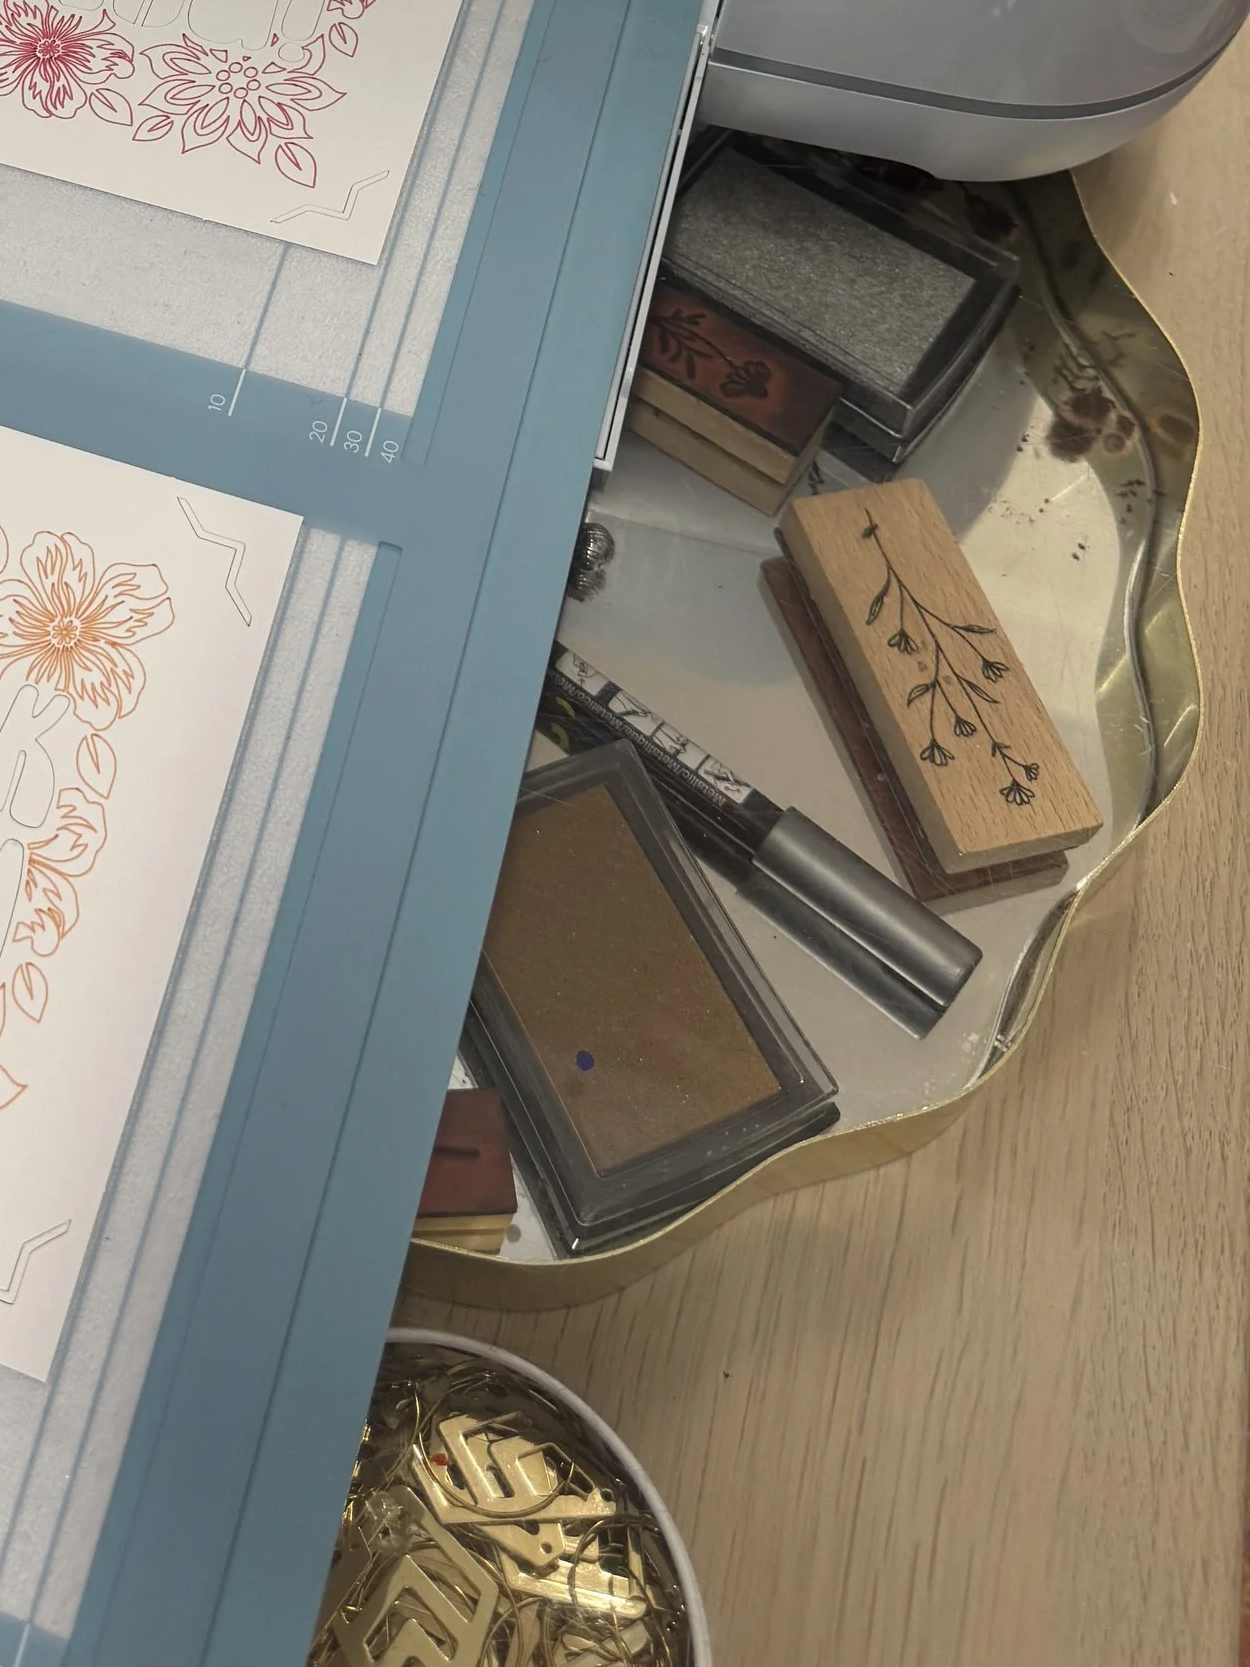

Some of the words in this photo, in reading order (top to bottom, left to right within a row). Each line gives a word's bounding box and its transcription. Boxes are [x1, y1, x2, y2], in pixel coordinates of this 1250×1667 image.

[207, 393, 227, 412] 10
[309, 420, 328, 444] 20
[343, 430, 363, 454] 30
[380, 440, 399, 464] 40
